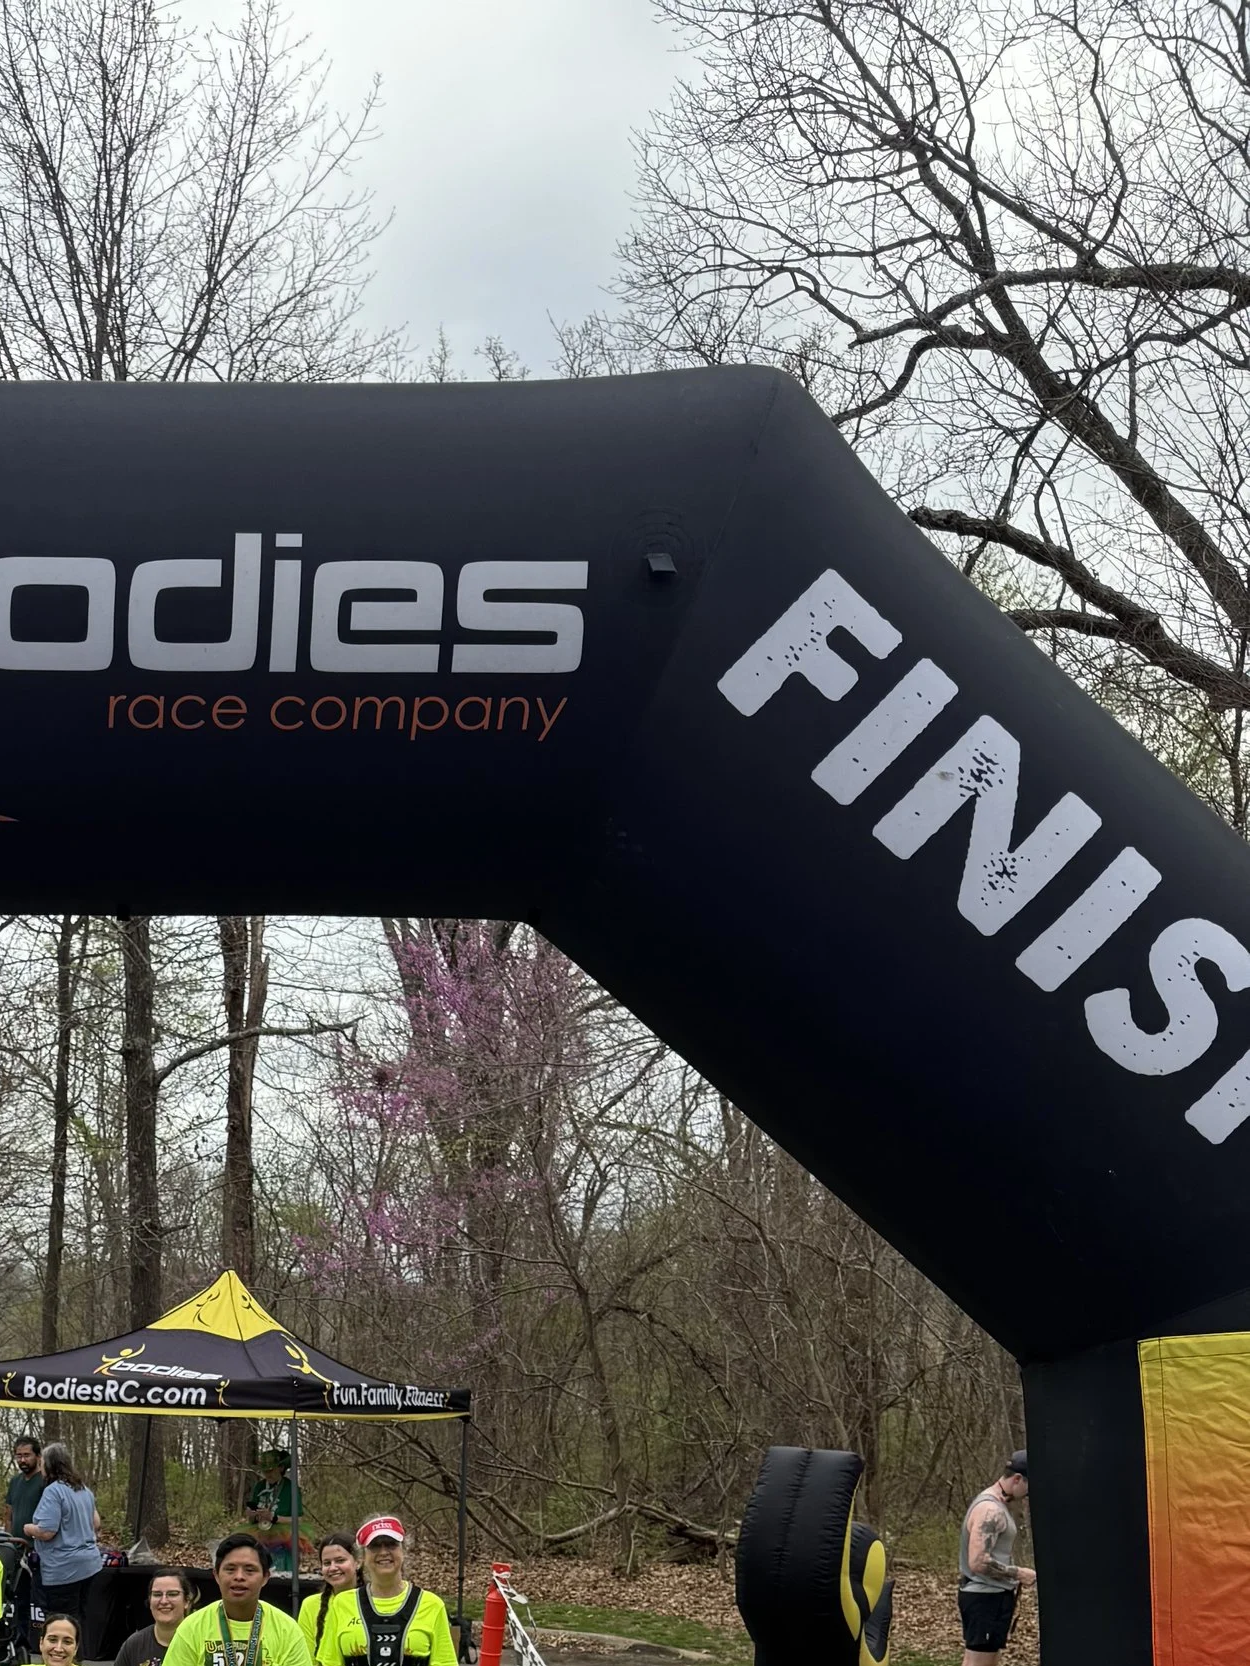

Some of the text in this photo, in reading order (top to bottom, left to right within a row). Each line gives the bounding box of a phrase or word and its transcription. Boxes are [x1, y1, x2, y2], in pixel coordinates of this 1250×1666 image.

[107, 694, 568, 741] race company
[110, 1360, 223, 1380] bodies
[23, 1376, 207, 1406] BodiesRC.com
